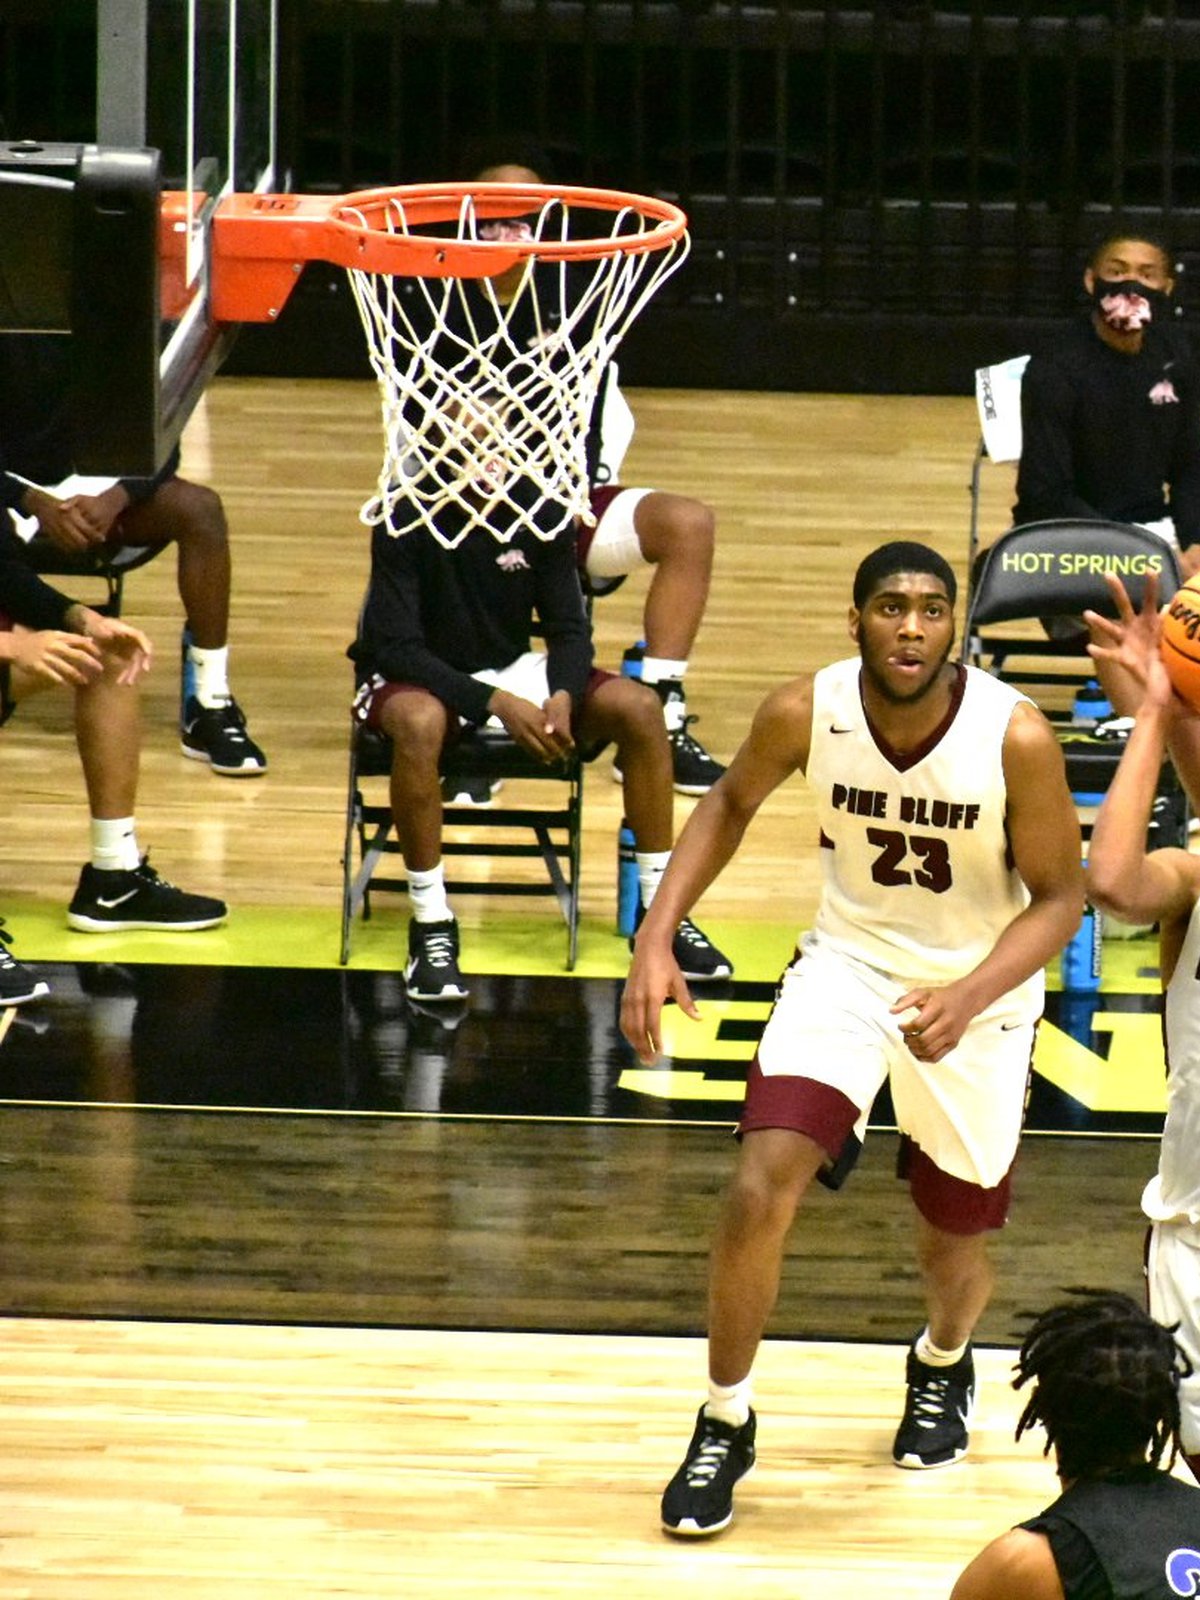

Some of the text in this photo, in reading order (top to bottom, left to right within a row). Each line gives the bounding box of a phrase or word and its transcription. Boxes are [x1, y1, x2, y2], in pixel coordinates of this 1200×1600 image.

[1002, 552, 1163, 575] HOT SPRINGS
[831, 782, 981, 830] PINE BLUFF
[866, 827, 953, 894] 23
